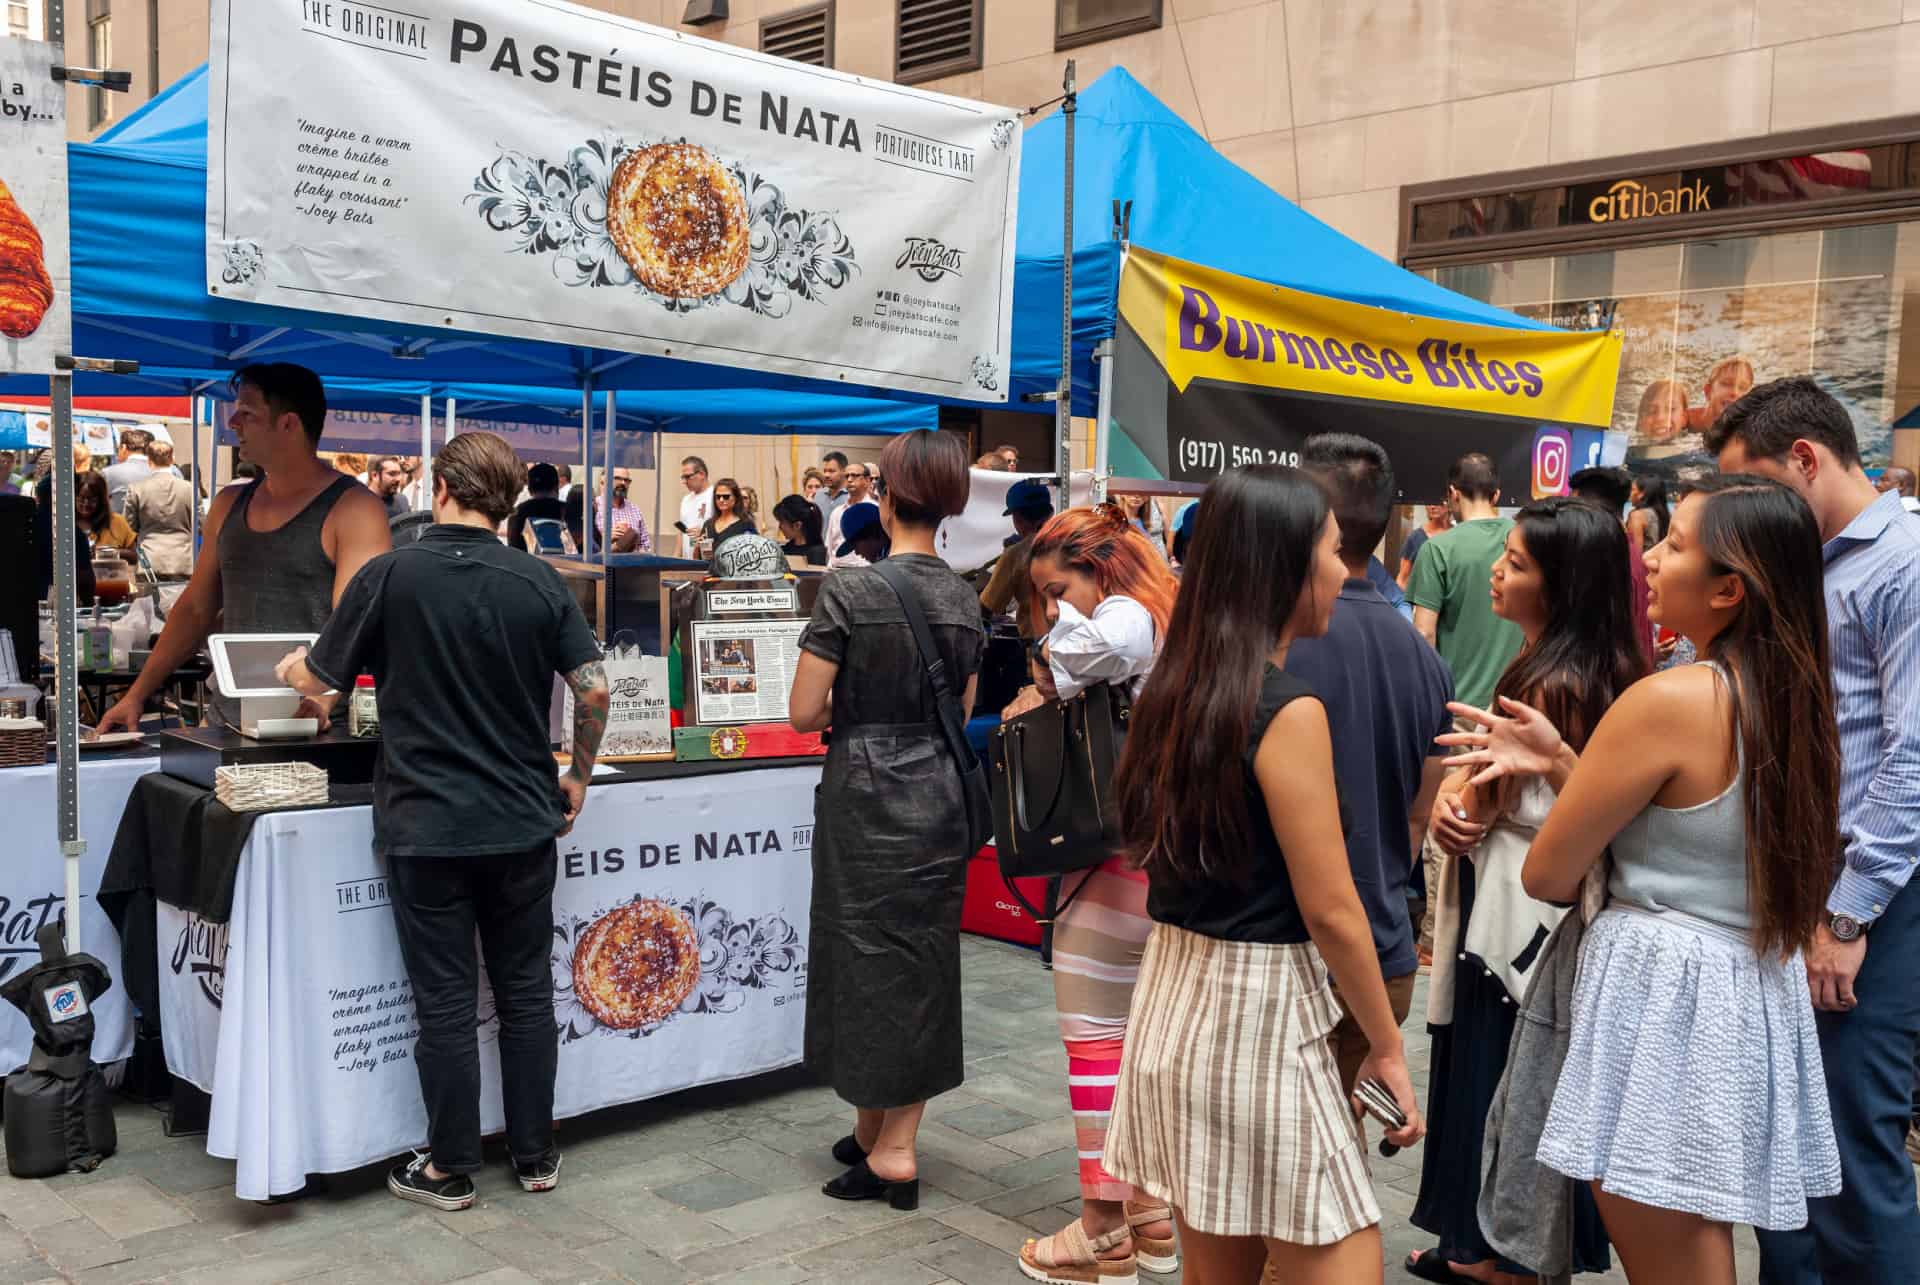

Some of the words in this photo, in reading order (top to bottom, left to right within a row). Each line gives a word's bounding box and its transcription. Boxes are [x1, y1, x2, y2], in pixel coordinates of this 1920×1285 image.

[302, 0, 332, 27] THE
[342, 8, 428, 50] ORIGINAL
[12, 82, 24, 96] a
[450, 18, 673, 108] PASTÉIS
[690, 80, 742, 125] DE
[759, 91, 862, 153] NATA
[361, 134, 371, 143] a
[376, 135, 412, 151] warm
[875, 130, 944, 168] PORTUGUESE
[949, 149, 976, 173] TART
[296, 162, 360, 181] wrapped
[363, 174, 377, 184] in
[383, 178, 392, 187] a
[294, 181, 334, 203] flaky
[1589, 177, 1711, 222] citibank
[343, 208, 374, 225] Bats
[1179, 284, 1414, 385] Burmese
[1417, 338, 1543, 397] Bites
[1179, 437, 1225, 475] (917)
[747, 595, 764, 606] York
[766, 595, 789, 604] Times
[565, 847, 625, 879] ÉIS
[640, 843, 681, 870] DE
[694, 830, 783, 862] NATA
[793, 829, 812, 846] POR
[337, 886, 361, 905] THE
[389, 979, 397, 991] a
[333, 1018, 391, 1038] wrapped
[395, 1013, 407, 1026] in
[334, 1039, 372, 1062] flaky
[377, 1030, 422, 1048] croissa
[382, 1051, 408, 1064] Bats
